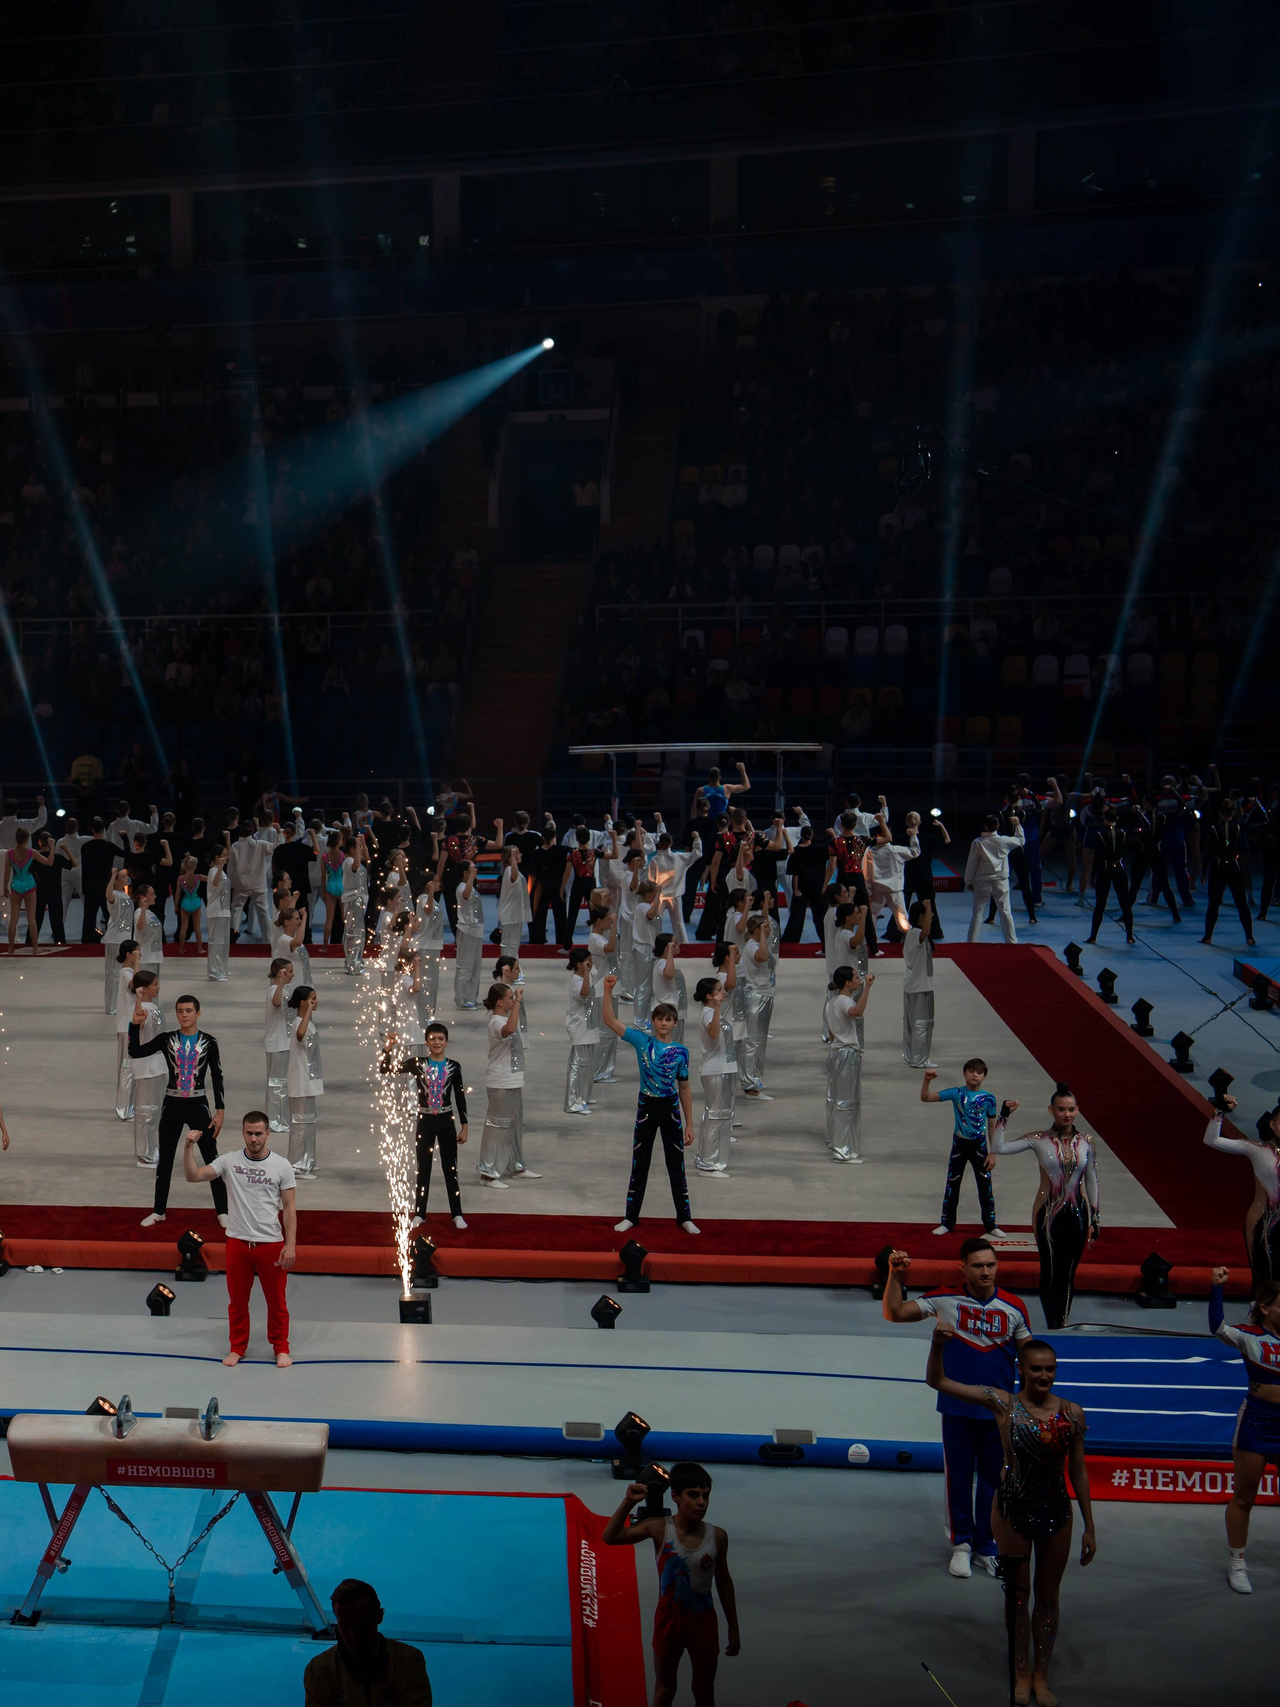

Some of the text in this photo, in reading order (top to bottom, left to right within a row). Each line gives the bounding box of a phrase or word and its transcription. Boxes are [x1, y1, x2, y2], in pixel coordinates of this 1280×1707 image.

[233, 1165, 266, 1177] BOSCO
[956, 1302, 1010, 1339] NO
[967, 1318, 1001, 1332] NAME
[116, 1464, 217, 1479] #НЕМОВШОУ
[49, 1501, 79, 1557] #НЕМОВШОУ
[256, 1504, 291, 1562] #НЕМОВШОУ
